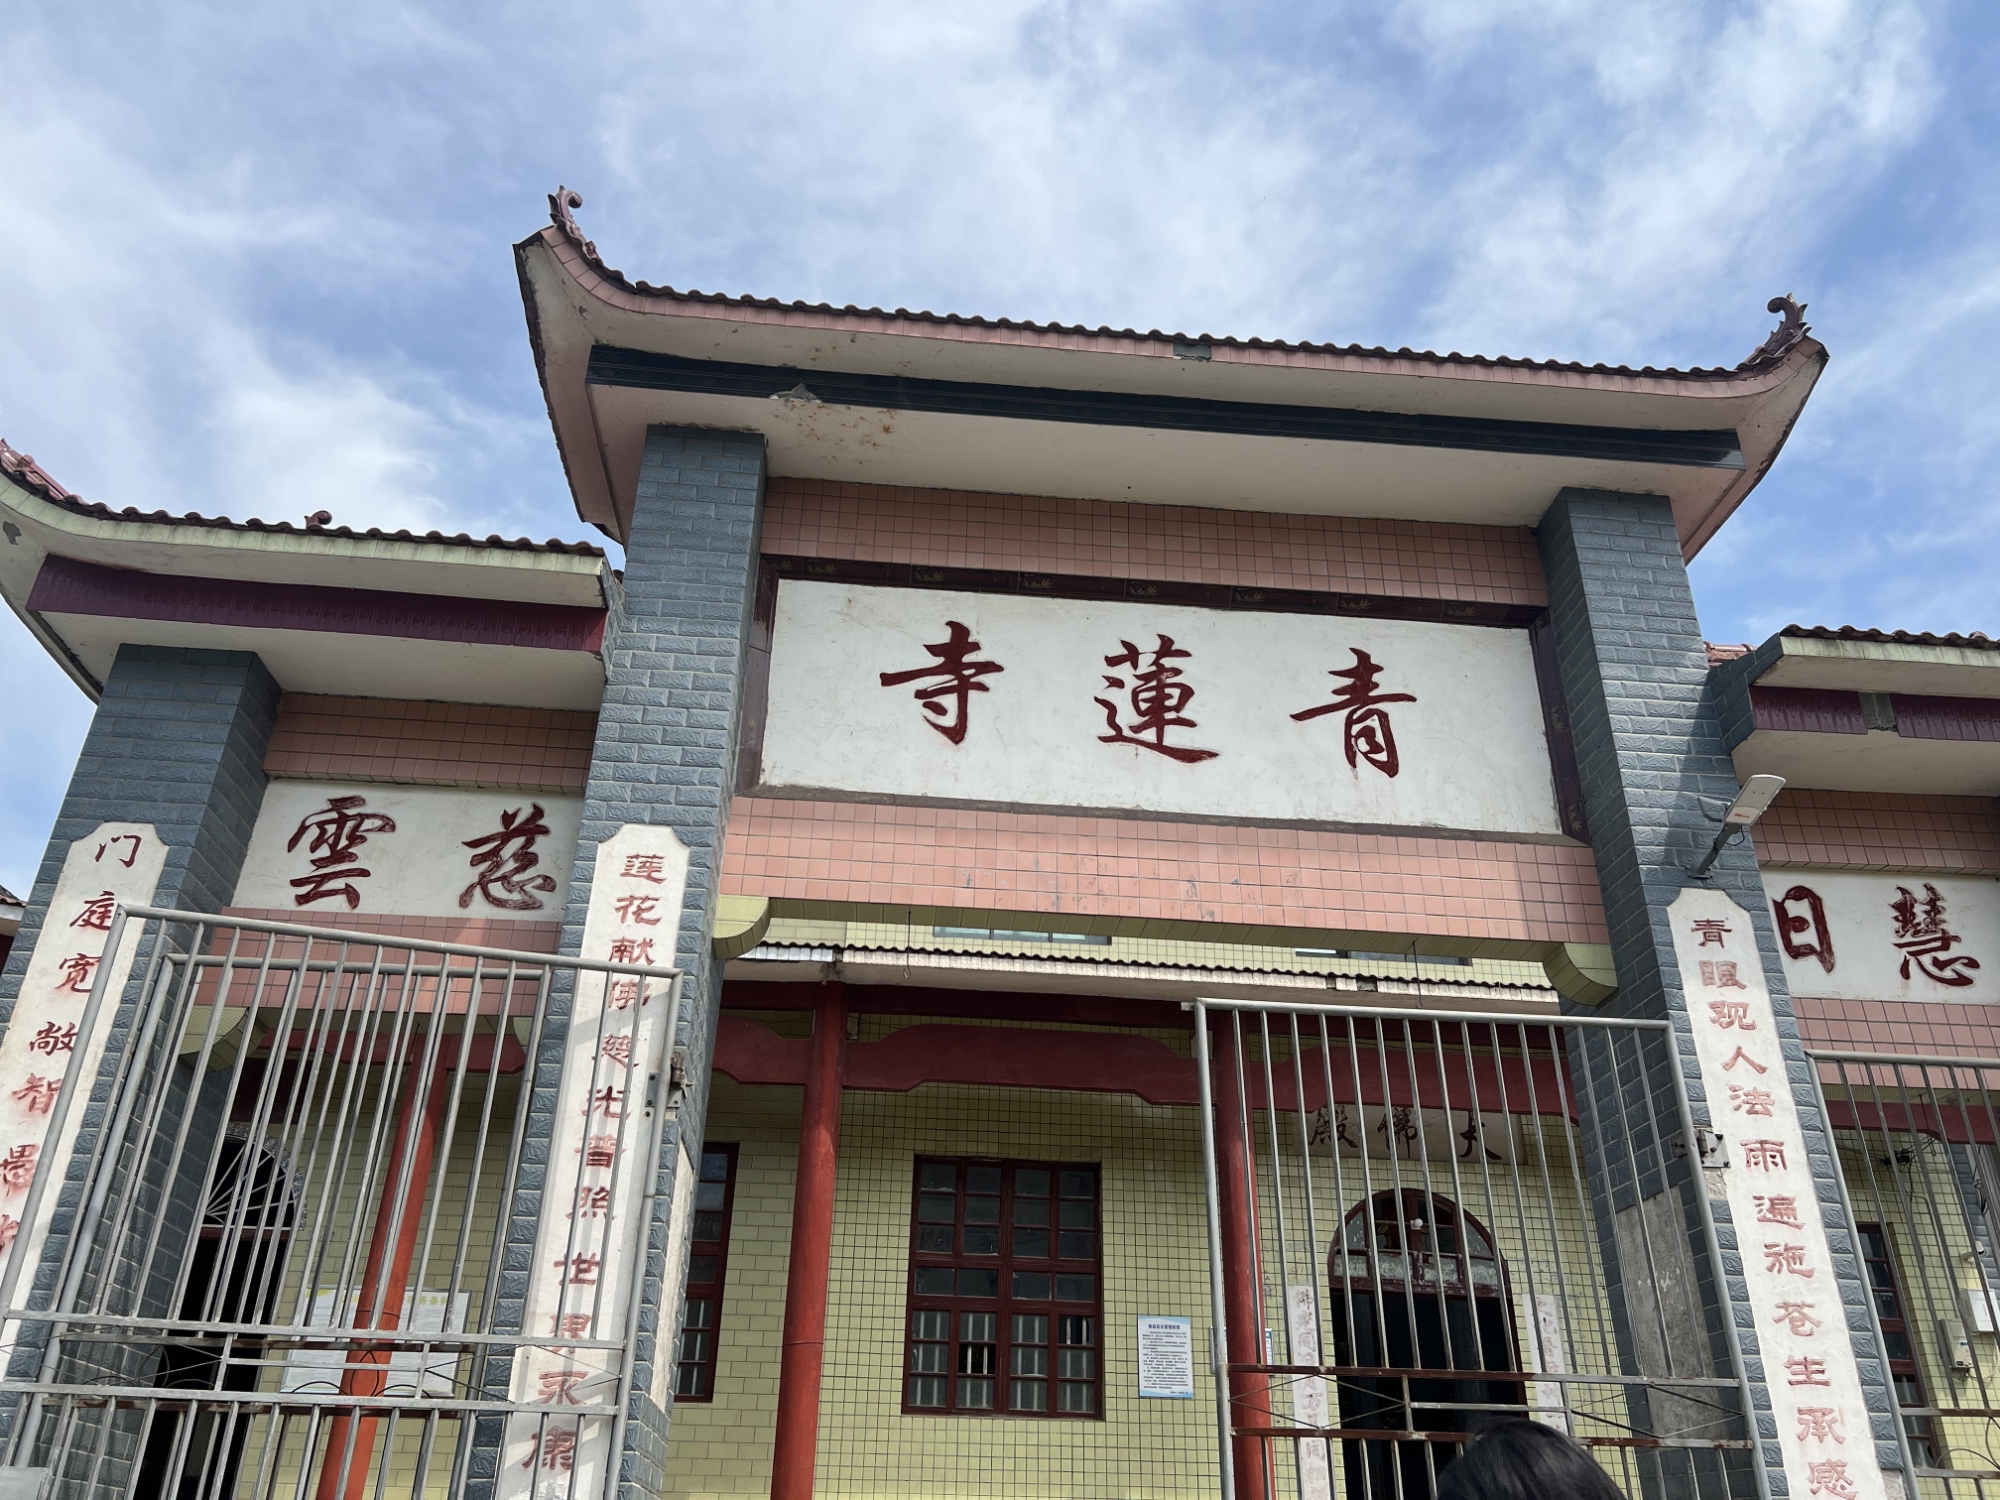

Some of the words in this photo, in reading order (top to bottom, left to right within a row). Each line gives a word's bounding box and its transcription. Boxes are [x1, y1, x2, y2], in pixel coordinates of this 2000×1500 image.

[880, 621, 1417, 779] 青蓮寺
[288, 795, 557, 911] 慈雲
[1771, 882, 1981, 987] 慧日
